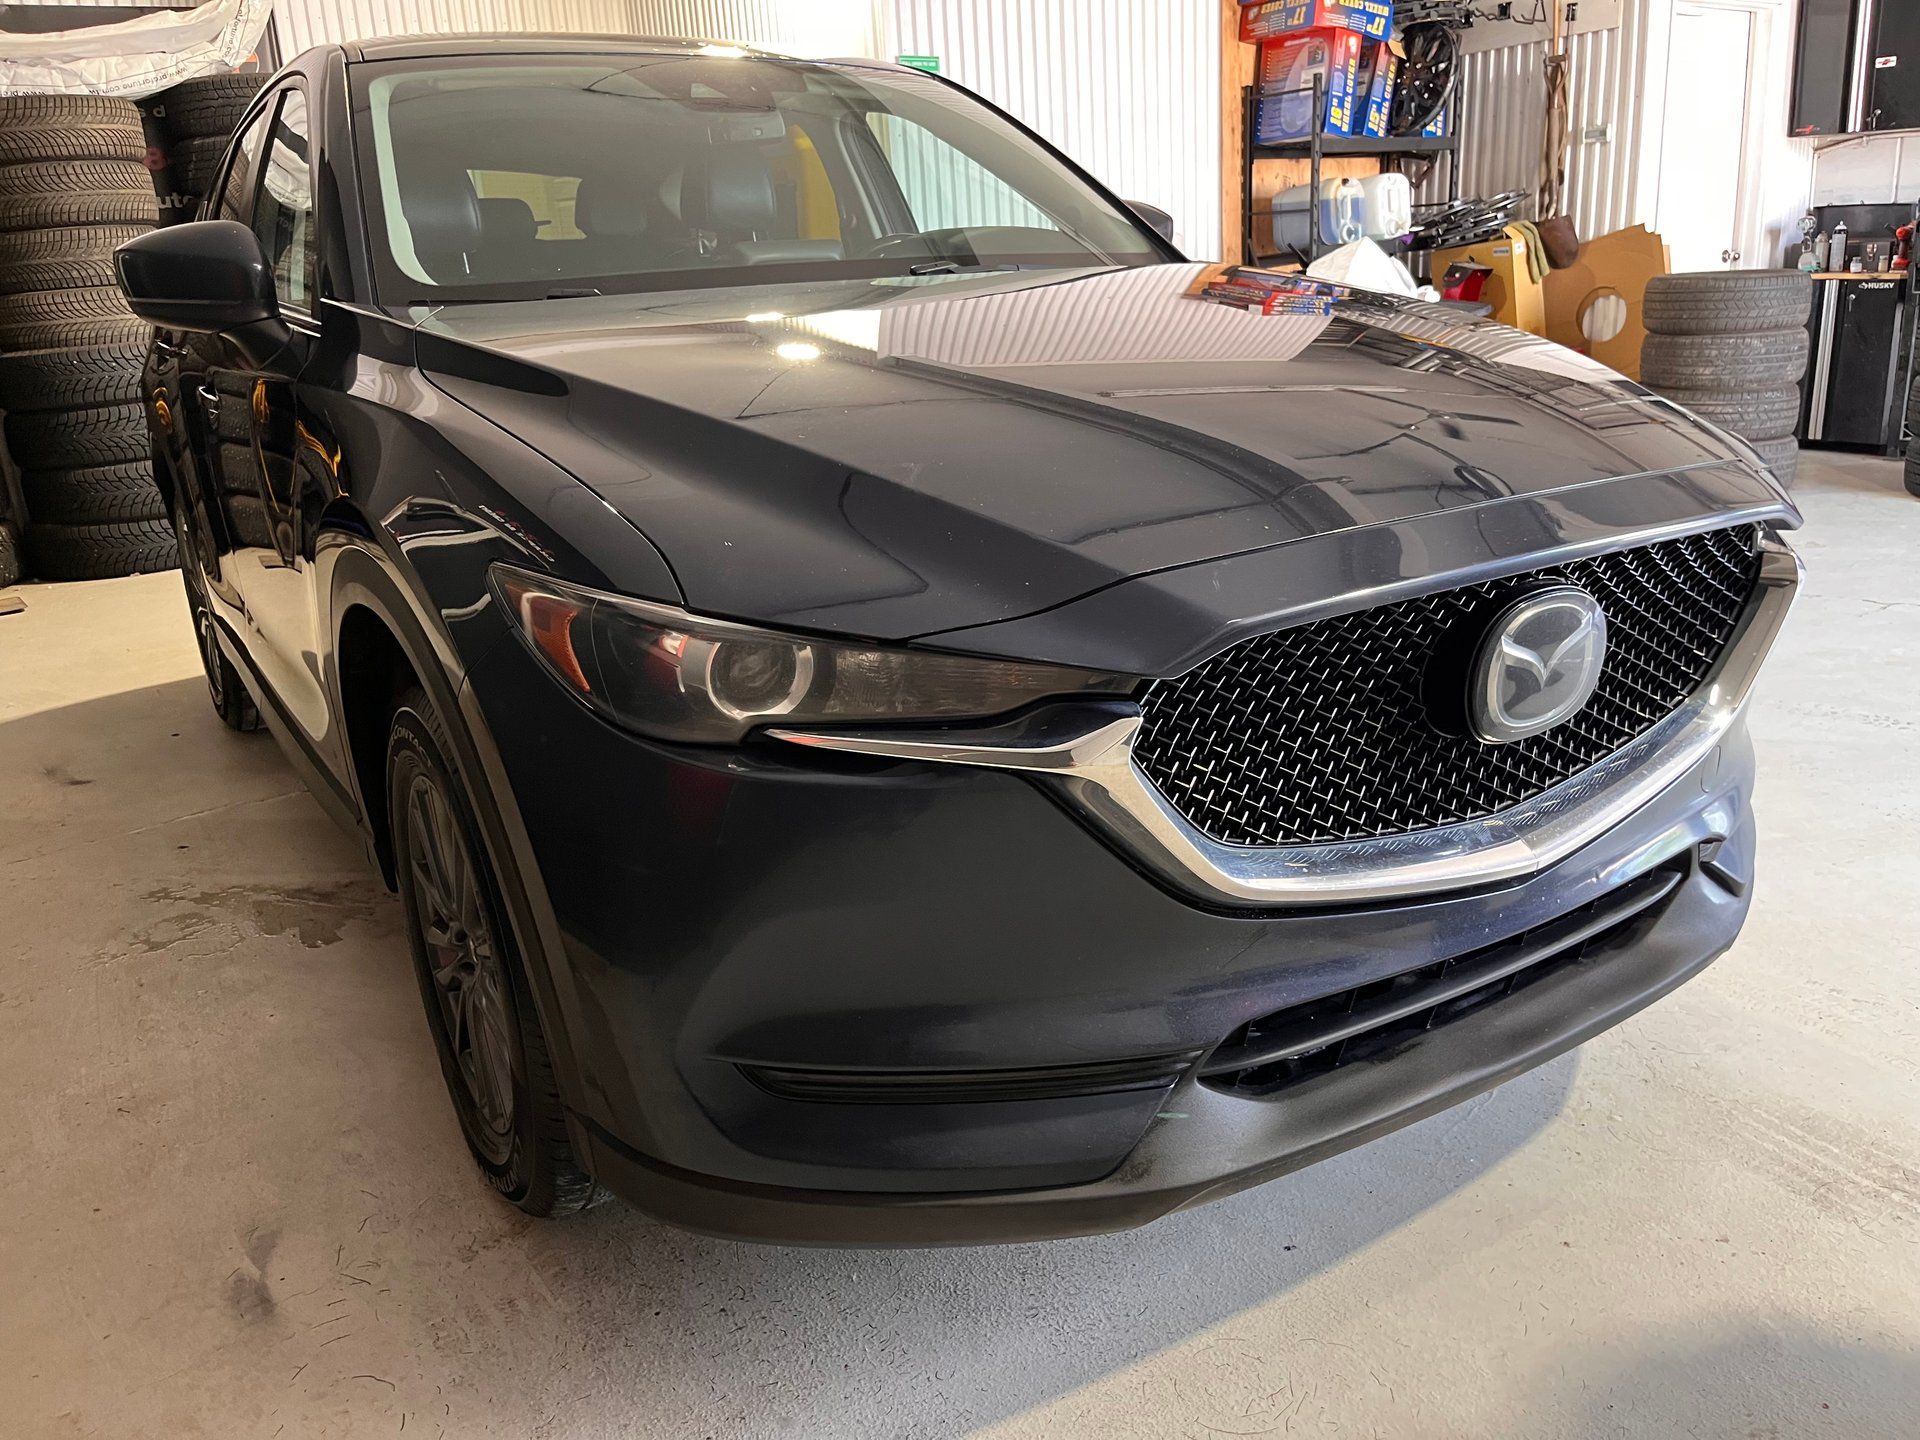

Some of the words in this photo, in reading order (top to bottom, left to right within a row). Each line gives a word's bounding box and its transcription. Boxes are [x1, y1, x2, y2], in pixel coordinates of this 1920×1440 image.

[1365, 2, 1389, 17] WHEEL
[1346, 57, 1356, 94] COVER
[1341, 95, 1352, 132] WHEEL
[1377, 101, 1389, 137] WHEEL
[1384, 62, 1396, 99] COVER
